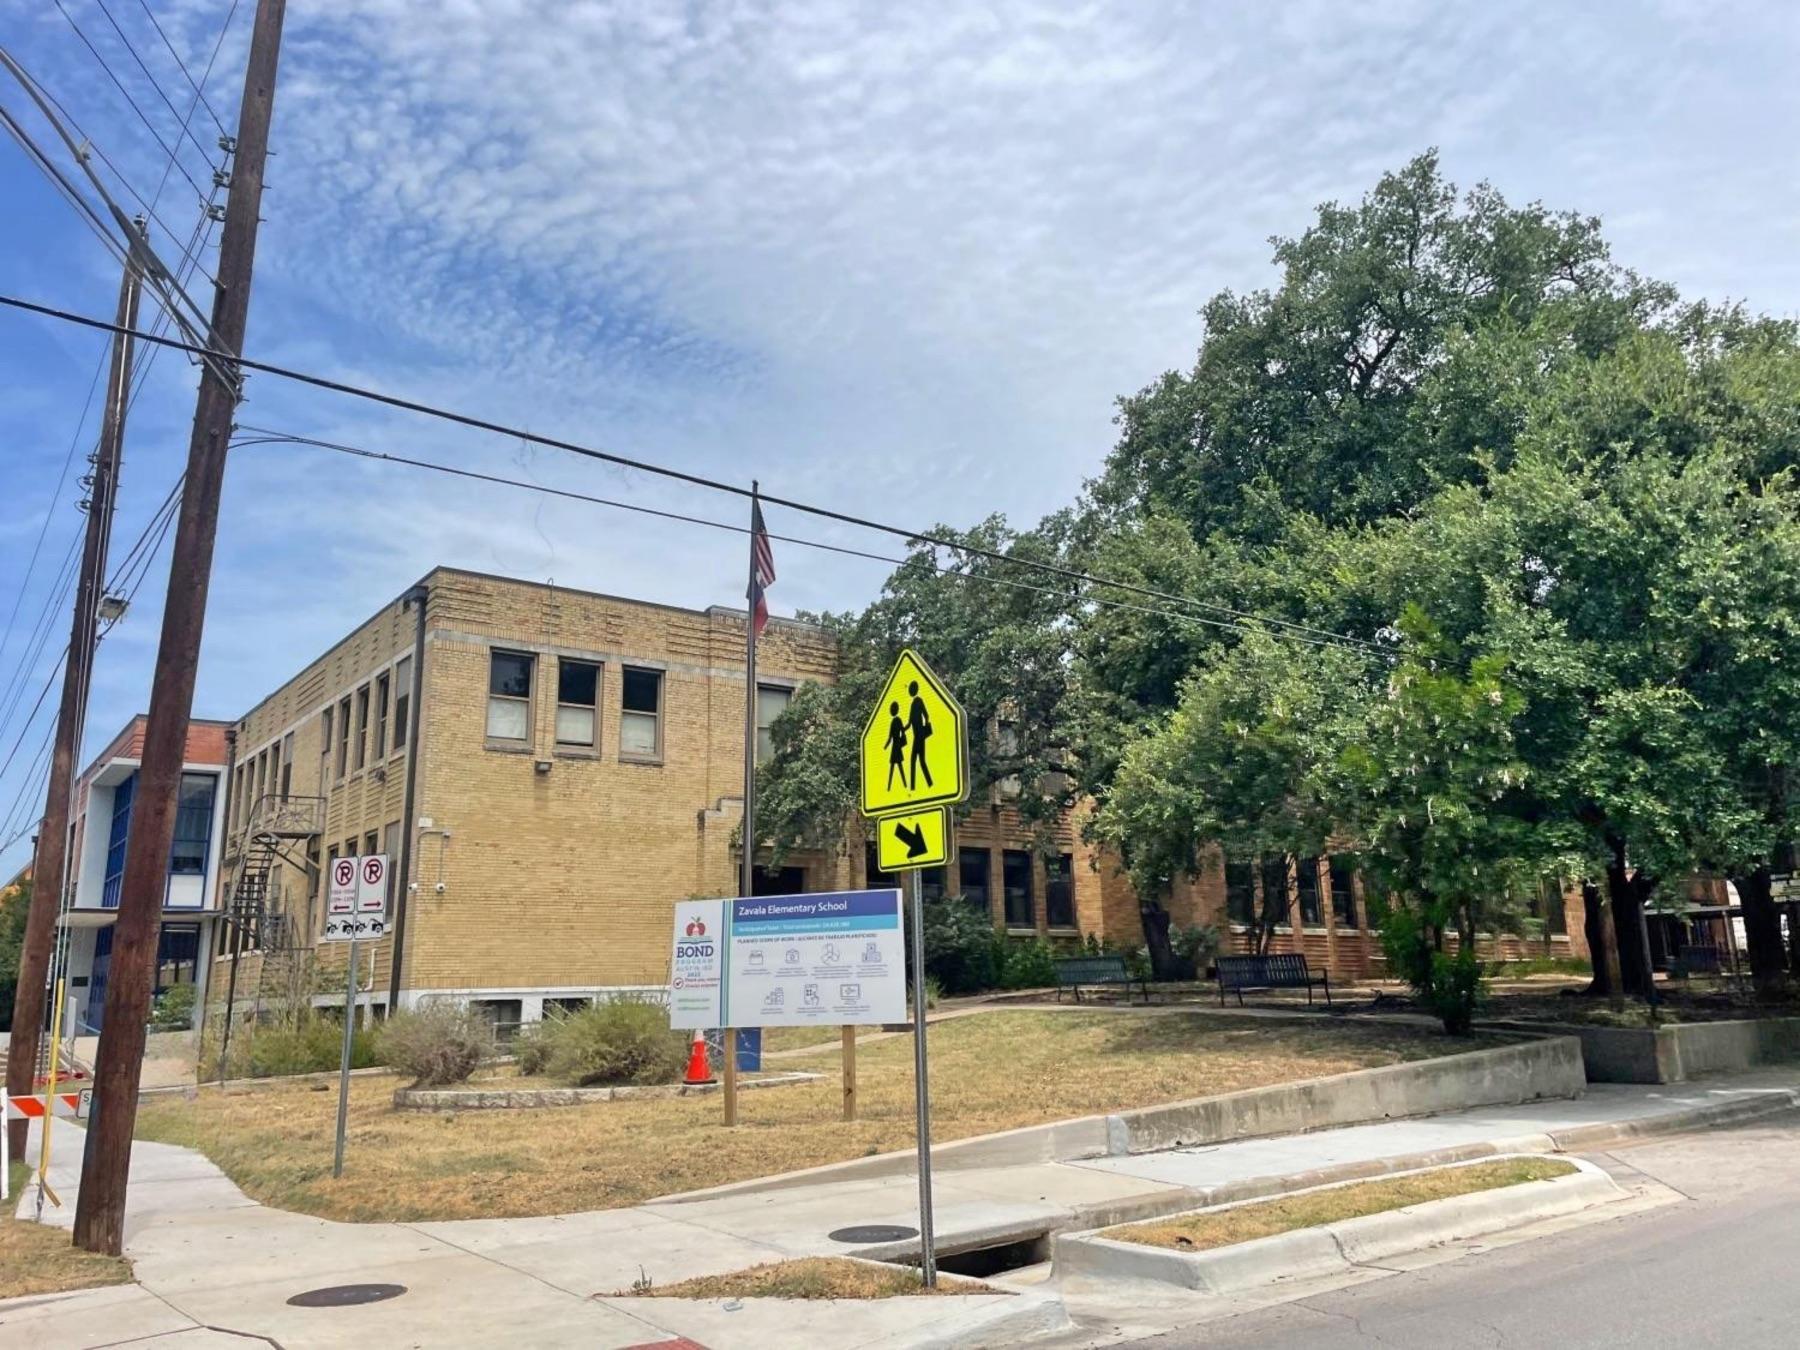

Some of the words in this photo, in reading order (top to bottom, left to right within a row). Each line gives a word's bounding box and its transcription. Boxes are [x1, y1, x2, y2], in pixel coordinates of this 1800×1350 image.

[738, 905, 767, 916] Zavala
[767, 904, 817, 914] Elementary
[818, 900, 848, 912] School
[677, 945, 714, 958] BOND
